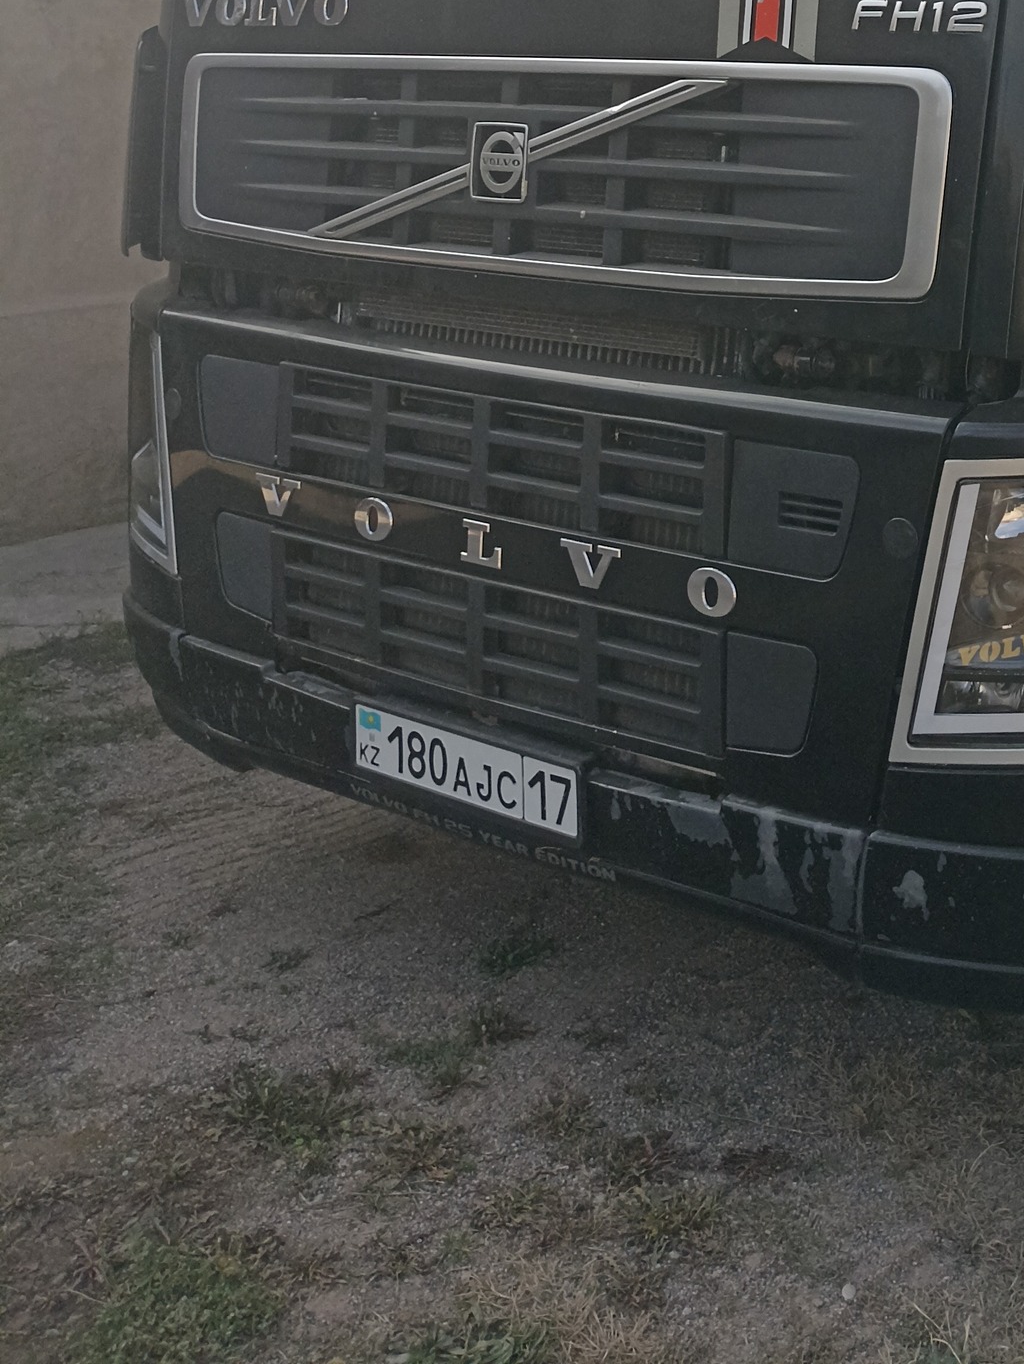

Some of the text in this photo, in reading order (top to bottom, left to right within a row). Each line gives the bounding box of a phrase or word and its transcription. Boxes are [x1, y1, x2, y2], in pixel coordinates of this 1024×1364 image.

[851, 0, 988, 33] FH12
[481, 157, 521, 167] VOLVO
[255, 472, 738, 618] VOLVO
[359, 741, 381, 767] KZ
[479, 829, 529, 857] YEAR
[534, 844, 617, 883] EDITION
